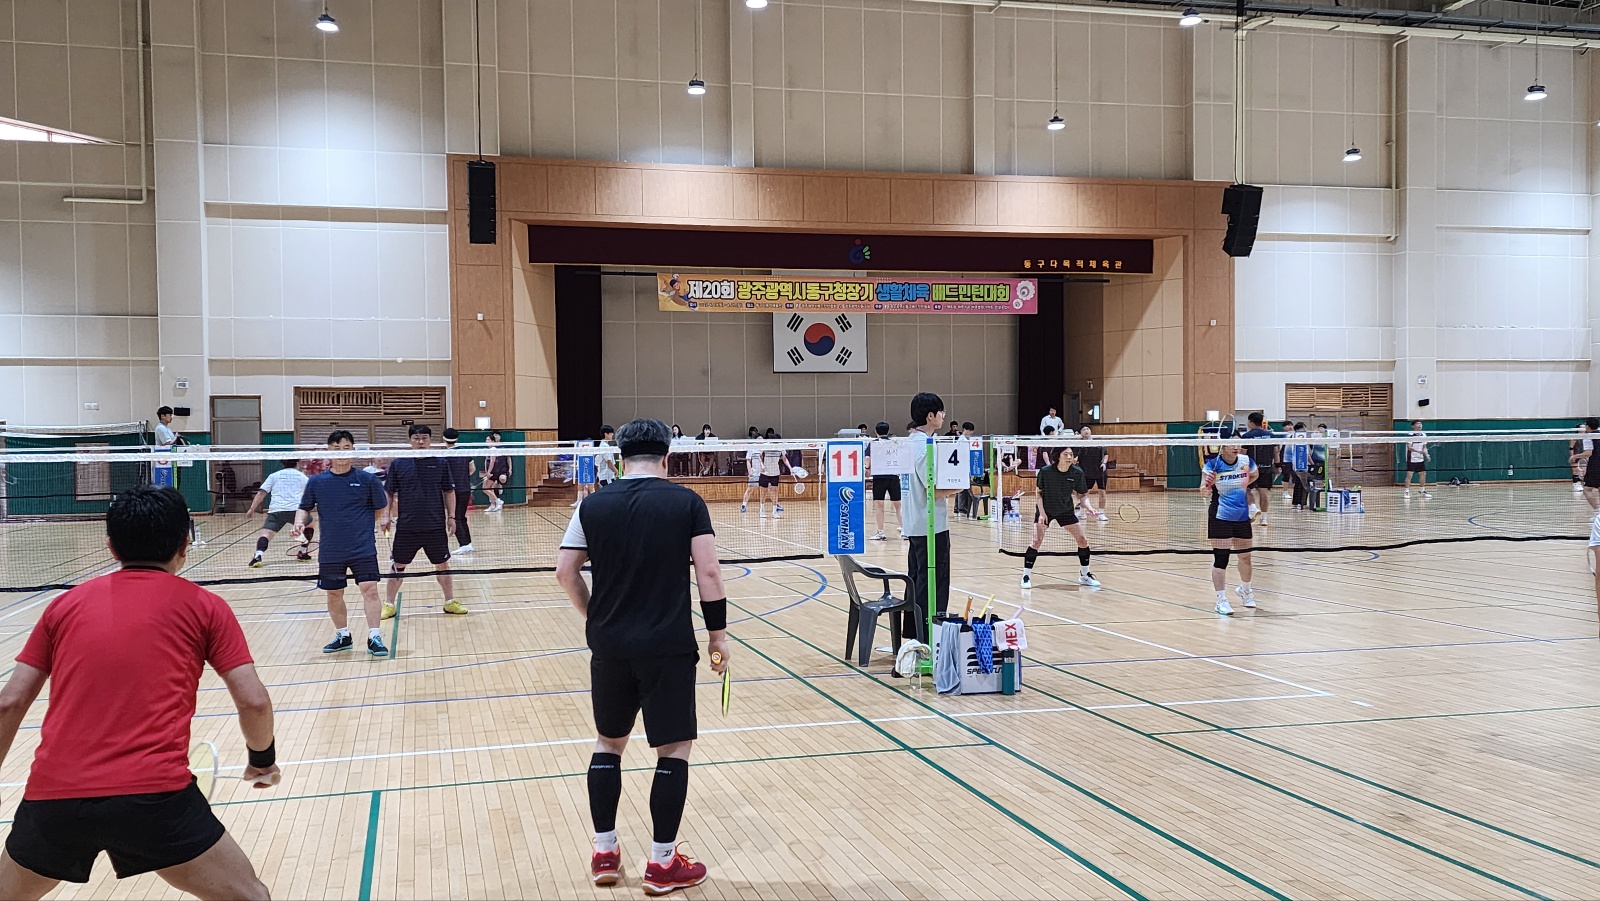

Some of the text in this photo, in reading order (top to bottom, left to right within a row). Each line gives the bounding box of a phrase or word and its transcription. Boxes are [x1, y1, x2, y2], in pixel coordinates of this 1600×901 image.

[688, 280, 735, 299] 제20회
[876, 282, 930, 302] 생활체육
[932, 283, 1010, 303] 배드민턴대회
[832, 450, 858, 477] 11
[948, 449, 960, 467] 4
[840, 503, 850, 550] SAMHAN
